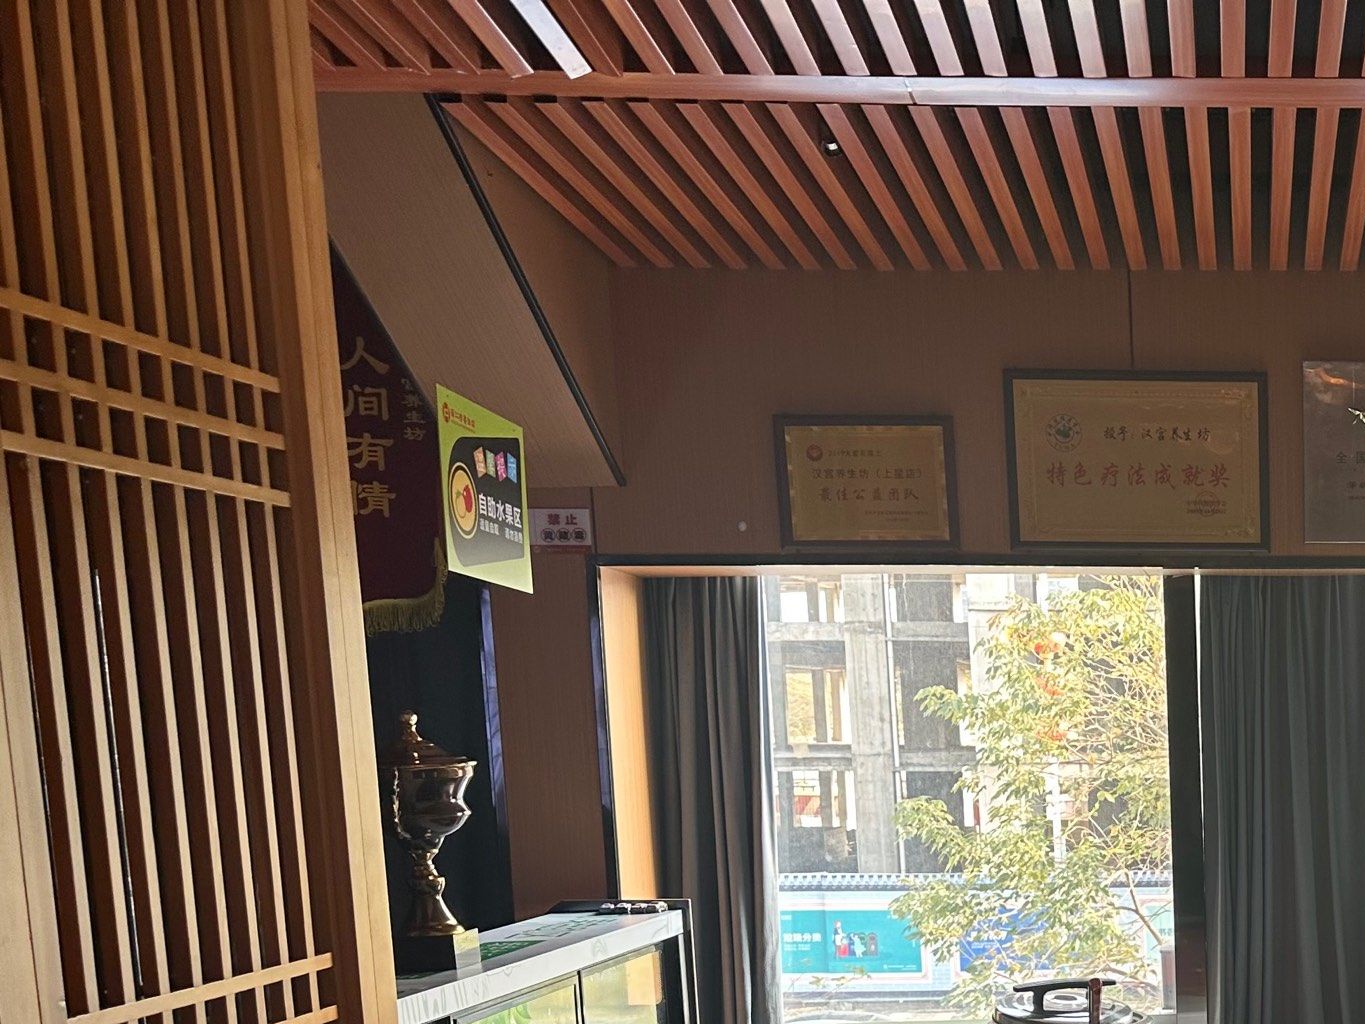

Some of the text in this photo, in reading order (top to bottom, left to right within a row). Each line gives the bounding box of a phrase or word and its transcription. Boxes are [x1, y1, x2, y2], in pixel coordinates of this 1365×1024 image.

[341, 336, 395, 518] 人间有情
[1046, 462, 1230, 490] 特色疗法成就奖
[478, 493, 522, 529] 自助水果区
[547, 513, 578, 526] 禁止
